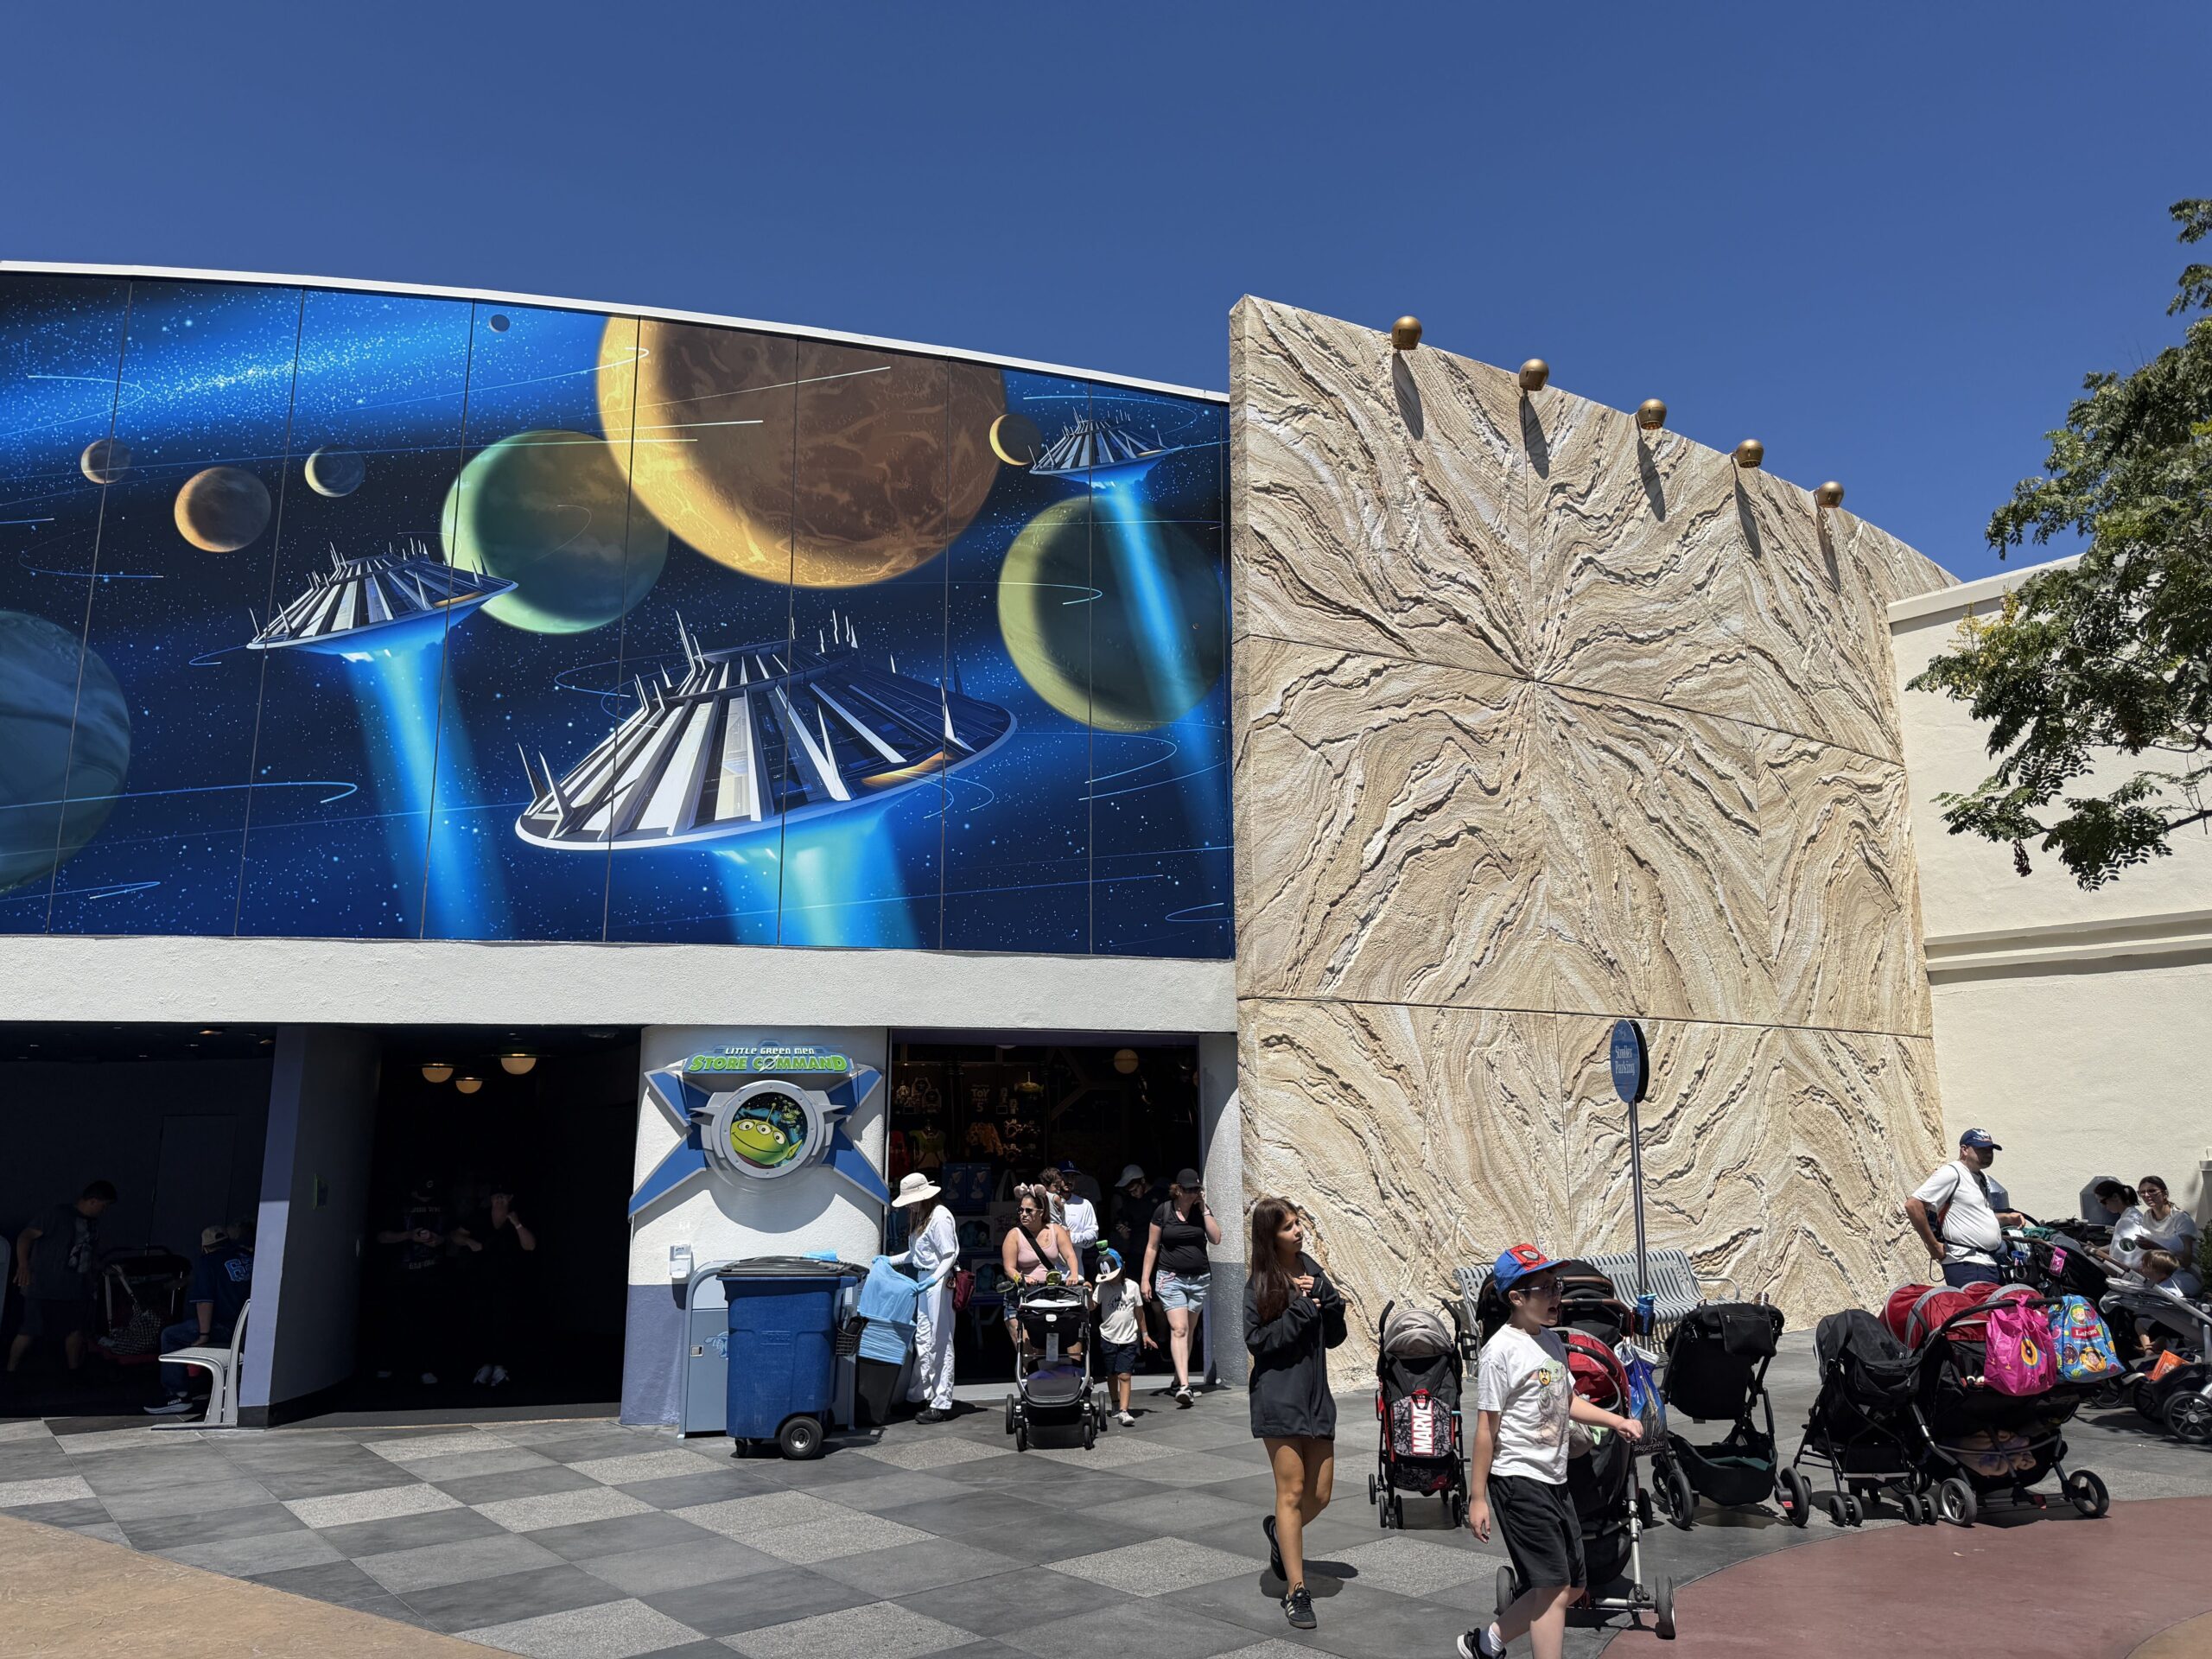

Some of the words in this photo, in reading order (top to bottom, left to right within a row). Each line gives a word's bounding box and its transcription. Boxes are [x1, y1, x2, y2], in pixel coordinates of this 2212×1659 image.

[1615, 1046, 1633, 1058] Stroller
[689, 1055, 747, 1071] STORE
[752, 1055, 848, 1071] COMMAND
[1615, 1060, 1636, 1076] Parking
